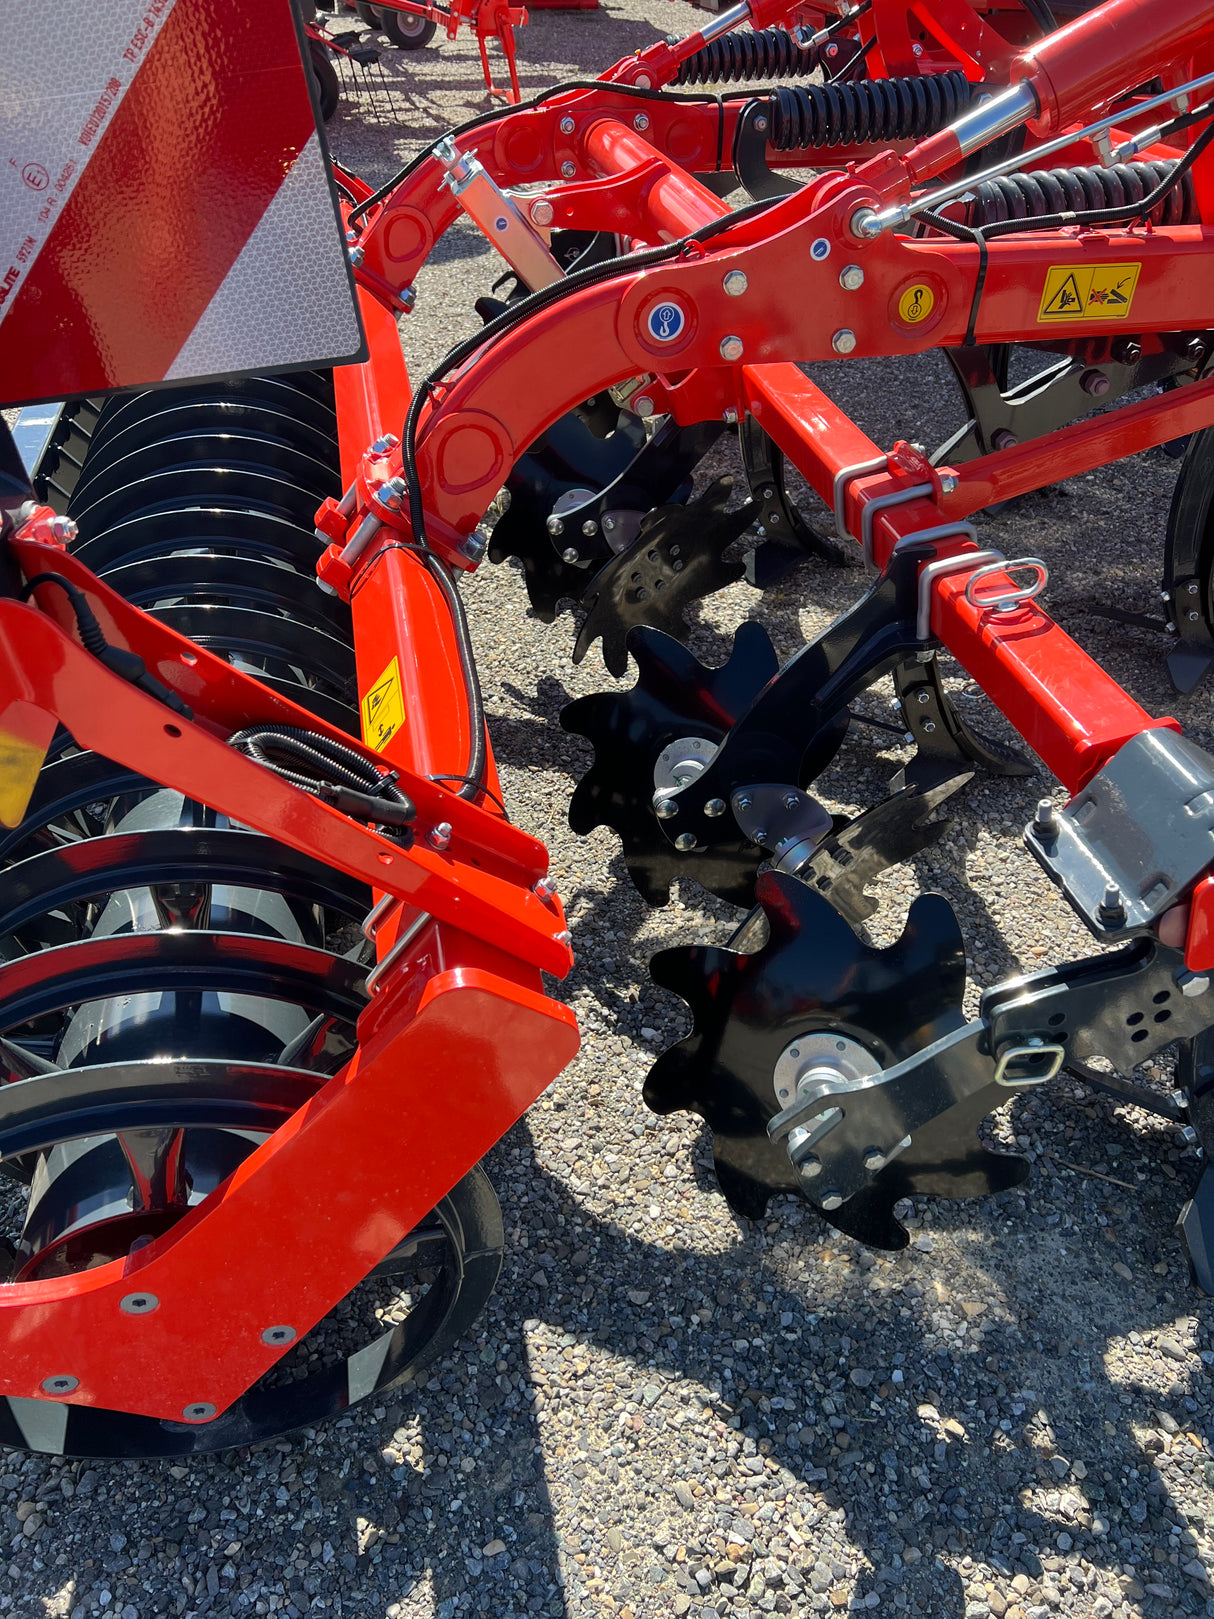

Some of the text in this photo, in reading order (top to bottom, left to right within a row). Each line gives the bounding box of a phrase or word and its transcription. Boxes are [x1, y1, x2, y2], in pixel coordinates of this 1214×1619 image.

[37, 206, 51, 223] 104
[46, 196, 57, 208] R
[123, 48, 137, 63] TP
[130, 17, 154, 50] ESC-B
